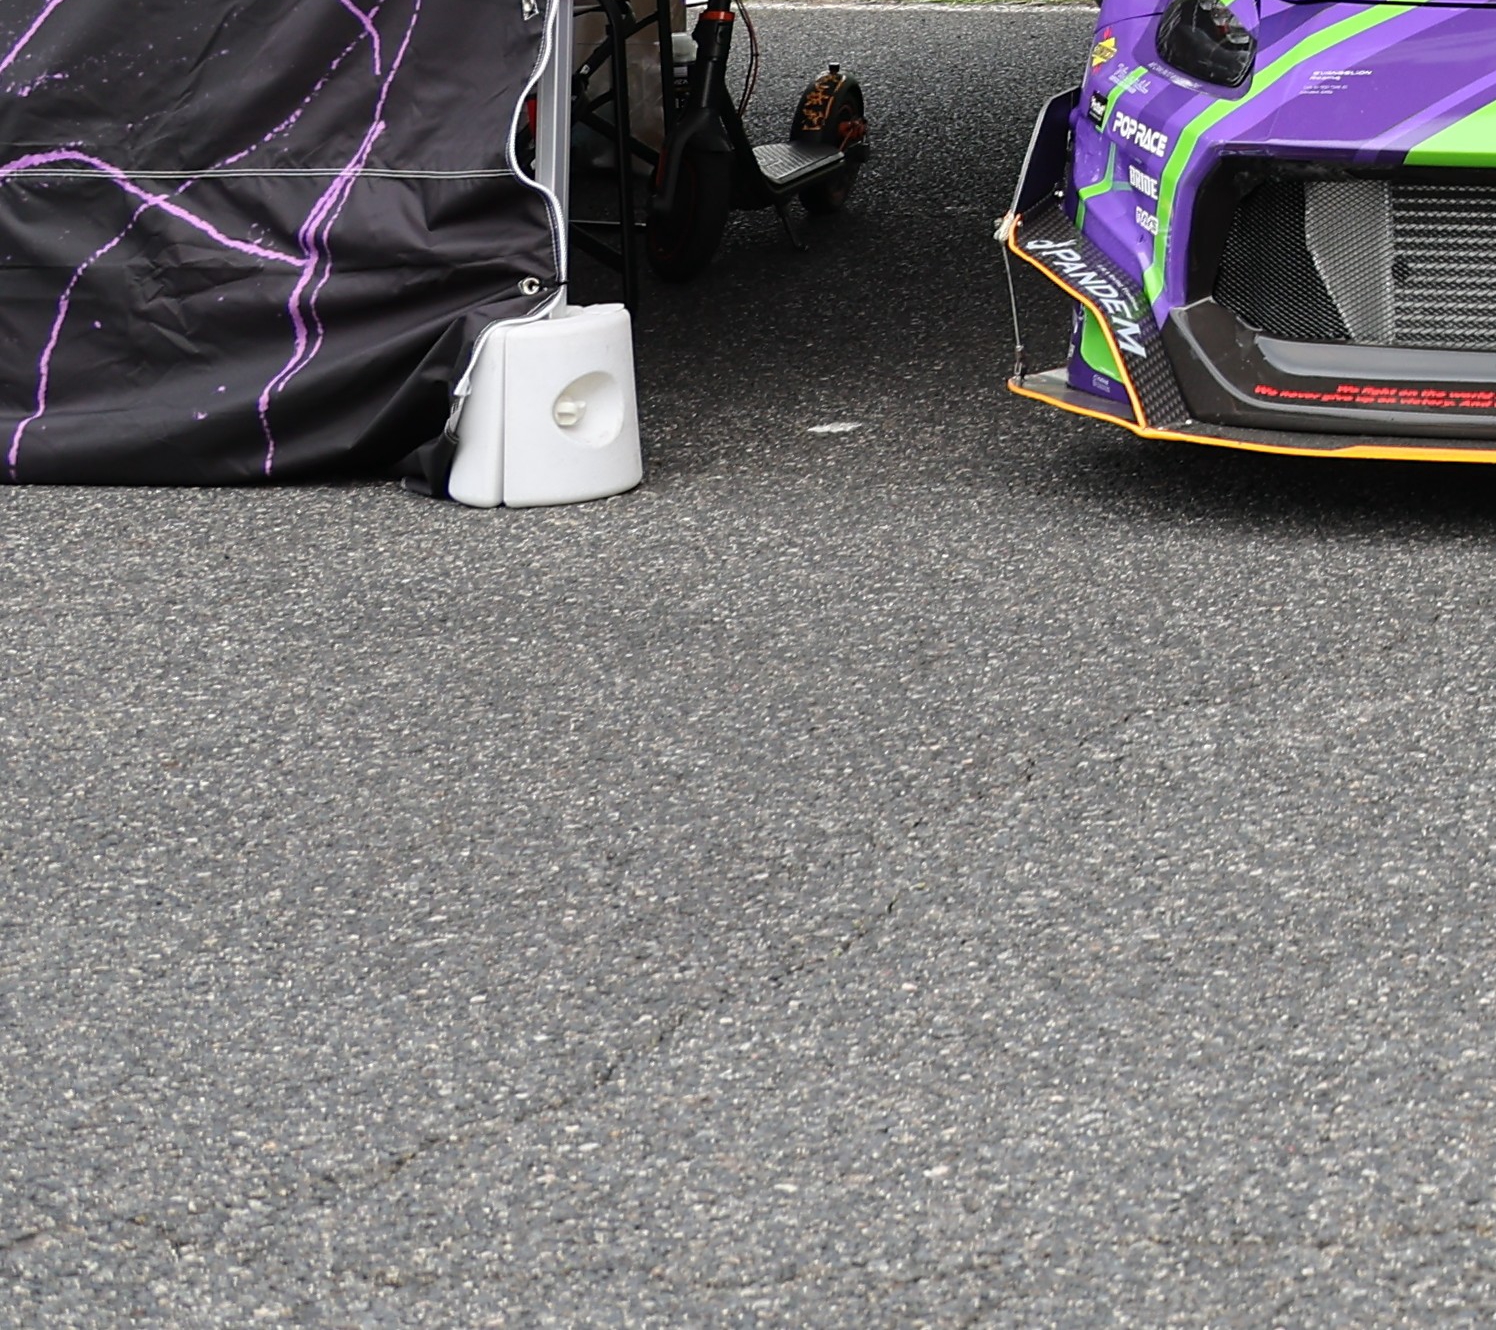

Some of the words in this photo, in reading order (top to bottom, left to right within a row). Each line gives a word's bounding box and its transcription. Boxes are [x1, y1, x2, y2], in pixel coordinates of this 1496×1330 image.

[1111, 110, 1138, 141] POP
[1134, 122, 1169, 159] RACE
[1128, 164, 1159, 201] BRIDE
